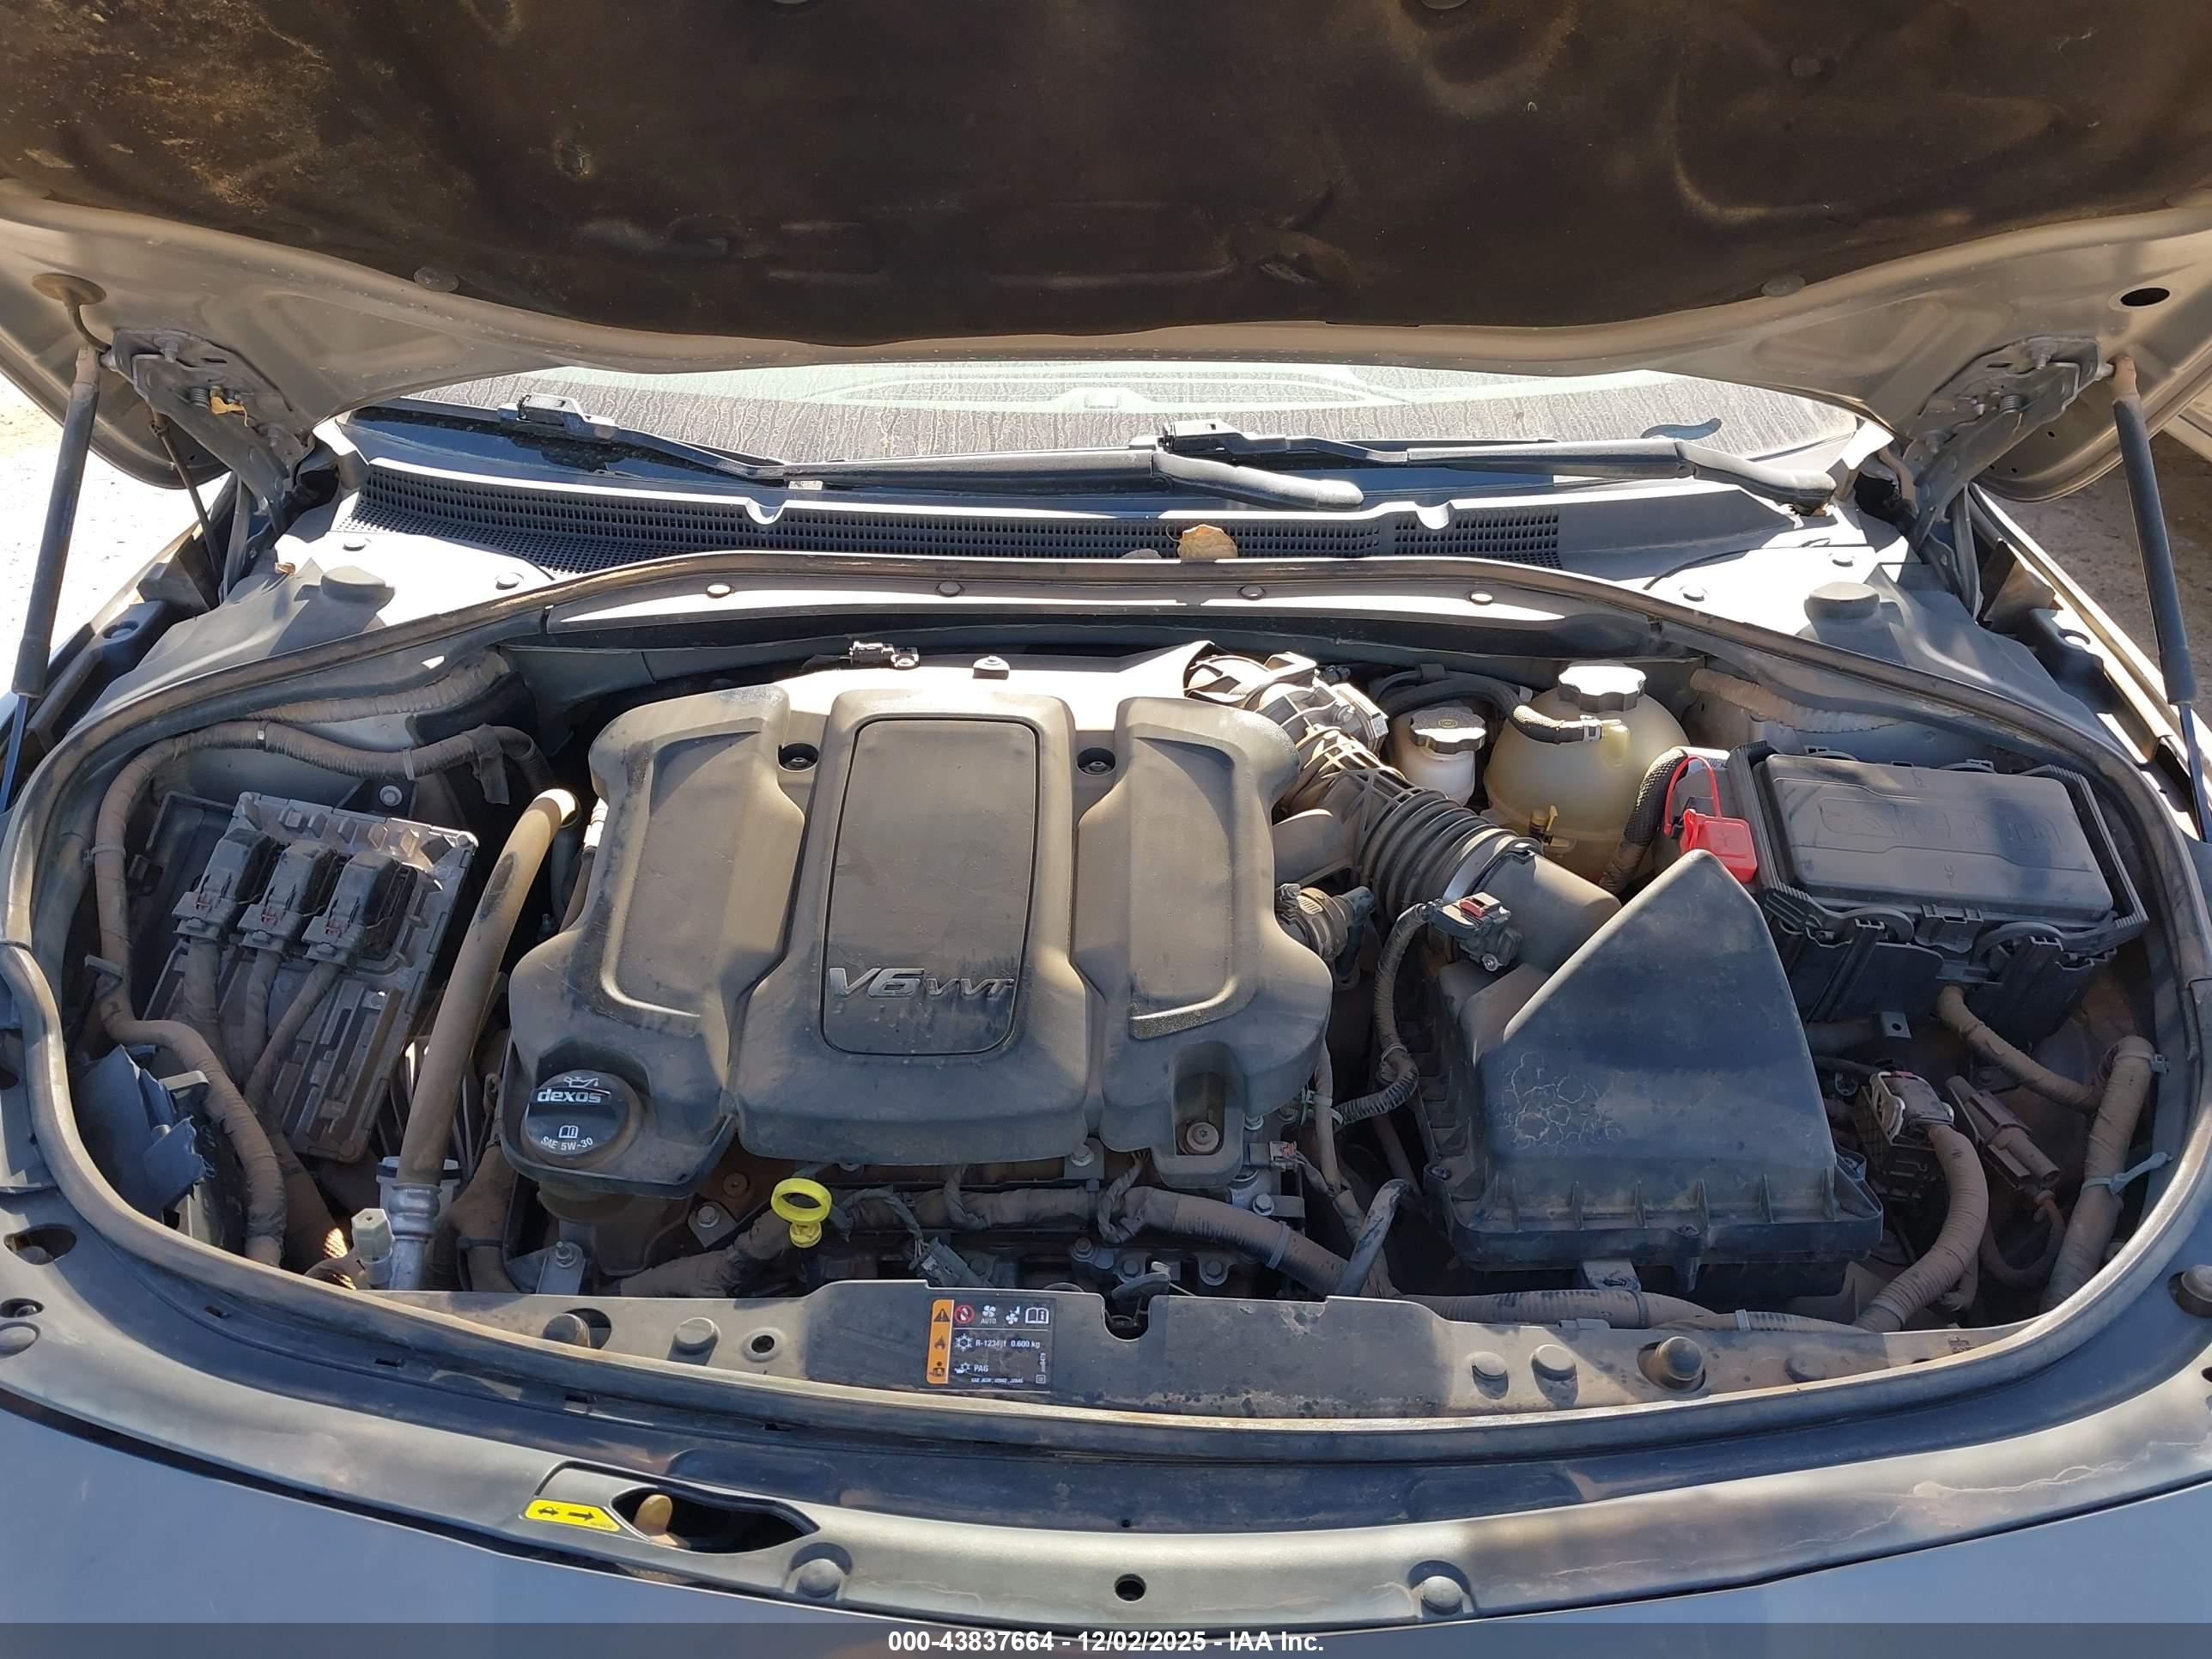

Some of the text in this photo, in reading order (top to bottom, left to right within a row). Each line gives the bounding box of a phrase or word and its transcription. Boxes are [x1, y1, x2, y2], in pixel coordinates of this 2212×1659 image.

[830, 968, 1014, 998] V6 VVT
[537, 1089, 601, 1103] dexos
[541, 1137, 593, 1151] SAE 5W-30
[1030, 1340, 1041, 1349] kg
[974, 1364, 989, 1372] PAG
